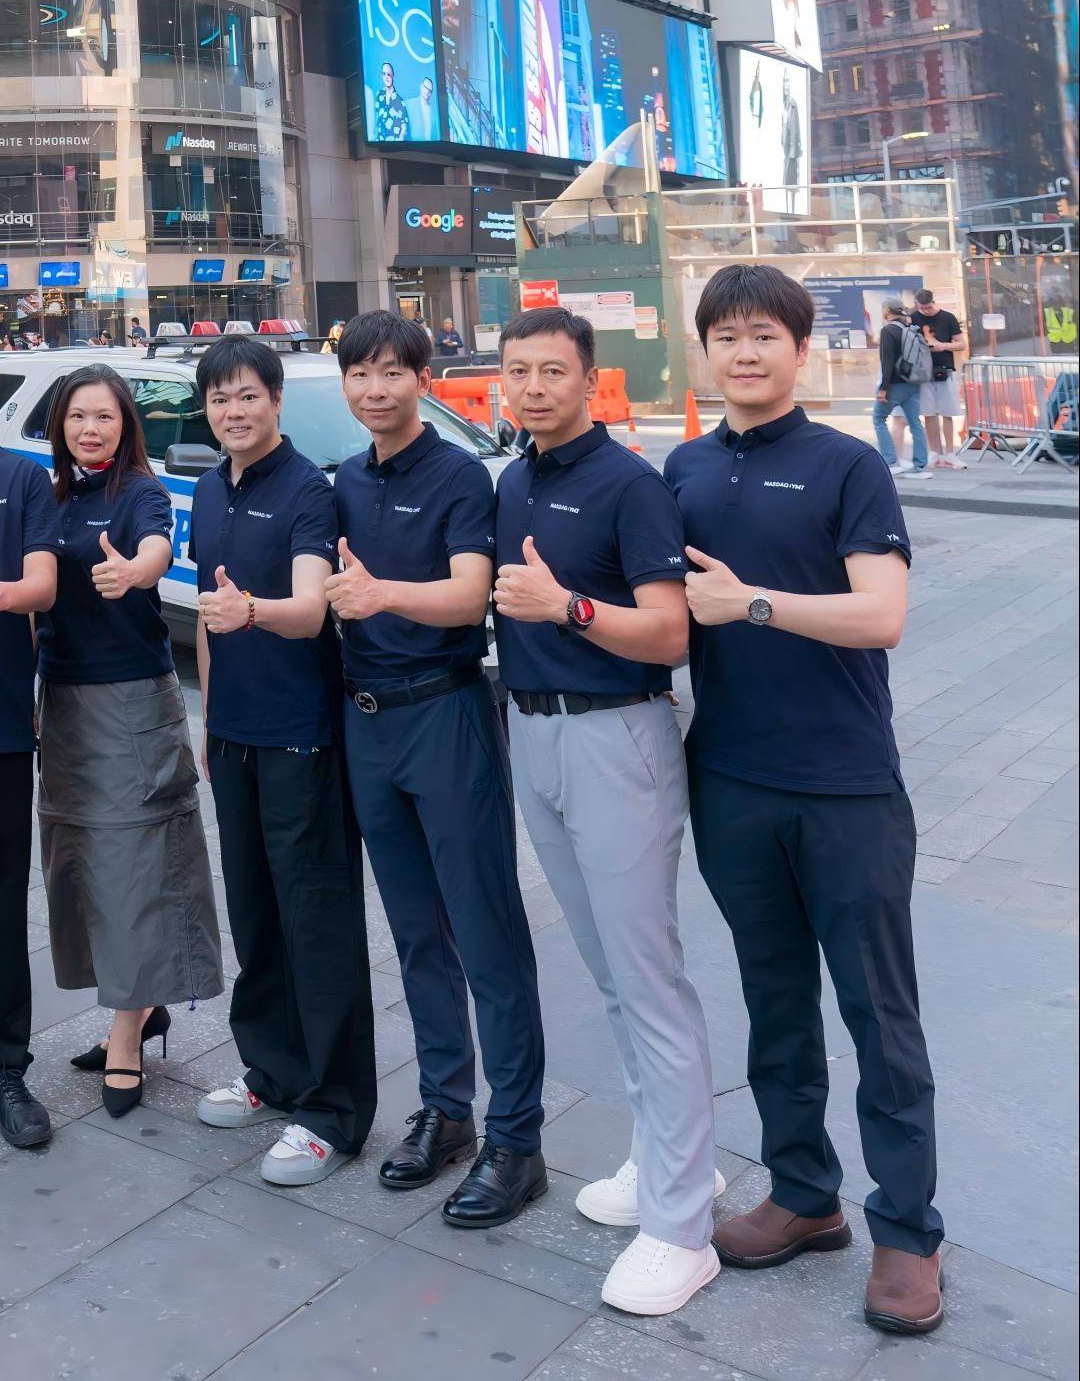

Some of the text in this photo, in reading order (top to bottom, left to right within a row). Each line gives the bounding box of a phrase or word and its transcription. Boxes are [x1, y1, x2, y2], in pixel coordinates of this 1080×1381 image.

[27, 136, 91, 147] TOMORROW
[182, 136, 216, 151] Nasdaq
[405, 207, 465, 234] Google
